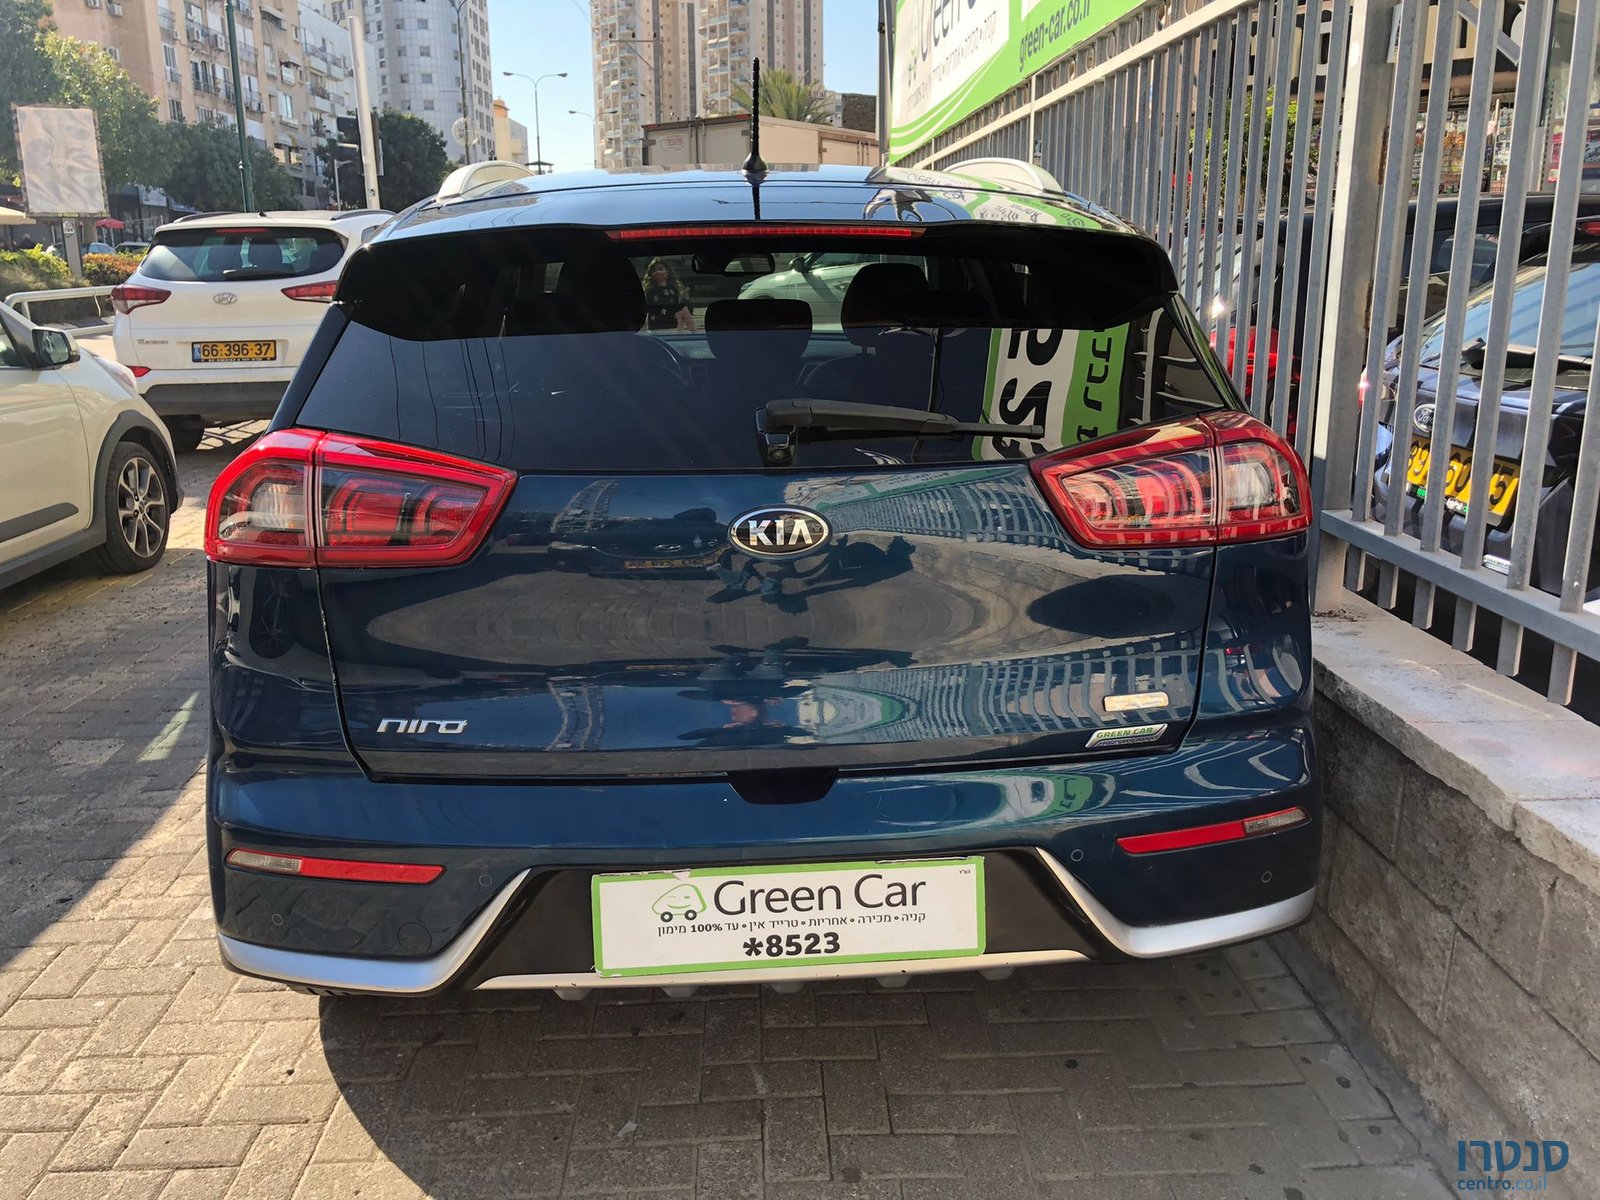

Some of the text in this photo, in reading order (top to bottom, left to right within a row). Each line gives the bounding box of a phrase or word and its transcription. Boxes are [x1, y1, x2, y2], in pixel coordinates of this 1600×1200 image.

[747, 519, 813, 546] KIA
[376, 718, 468, 733] niro
[1097, 727, 1154, 738] GREEN CAR
[713, 873, 926, 916] Green Car
[658, 911, 926, 937] קניה מכירה אחריות טרייד אין עד 100% מימון
